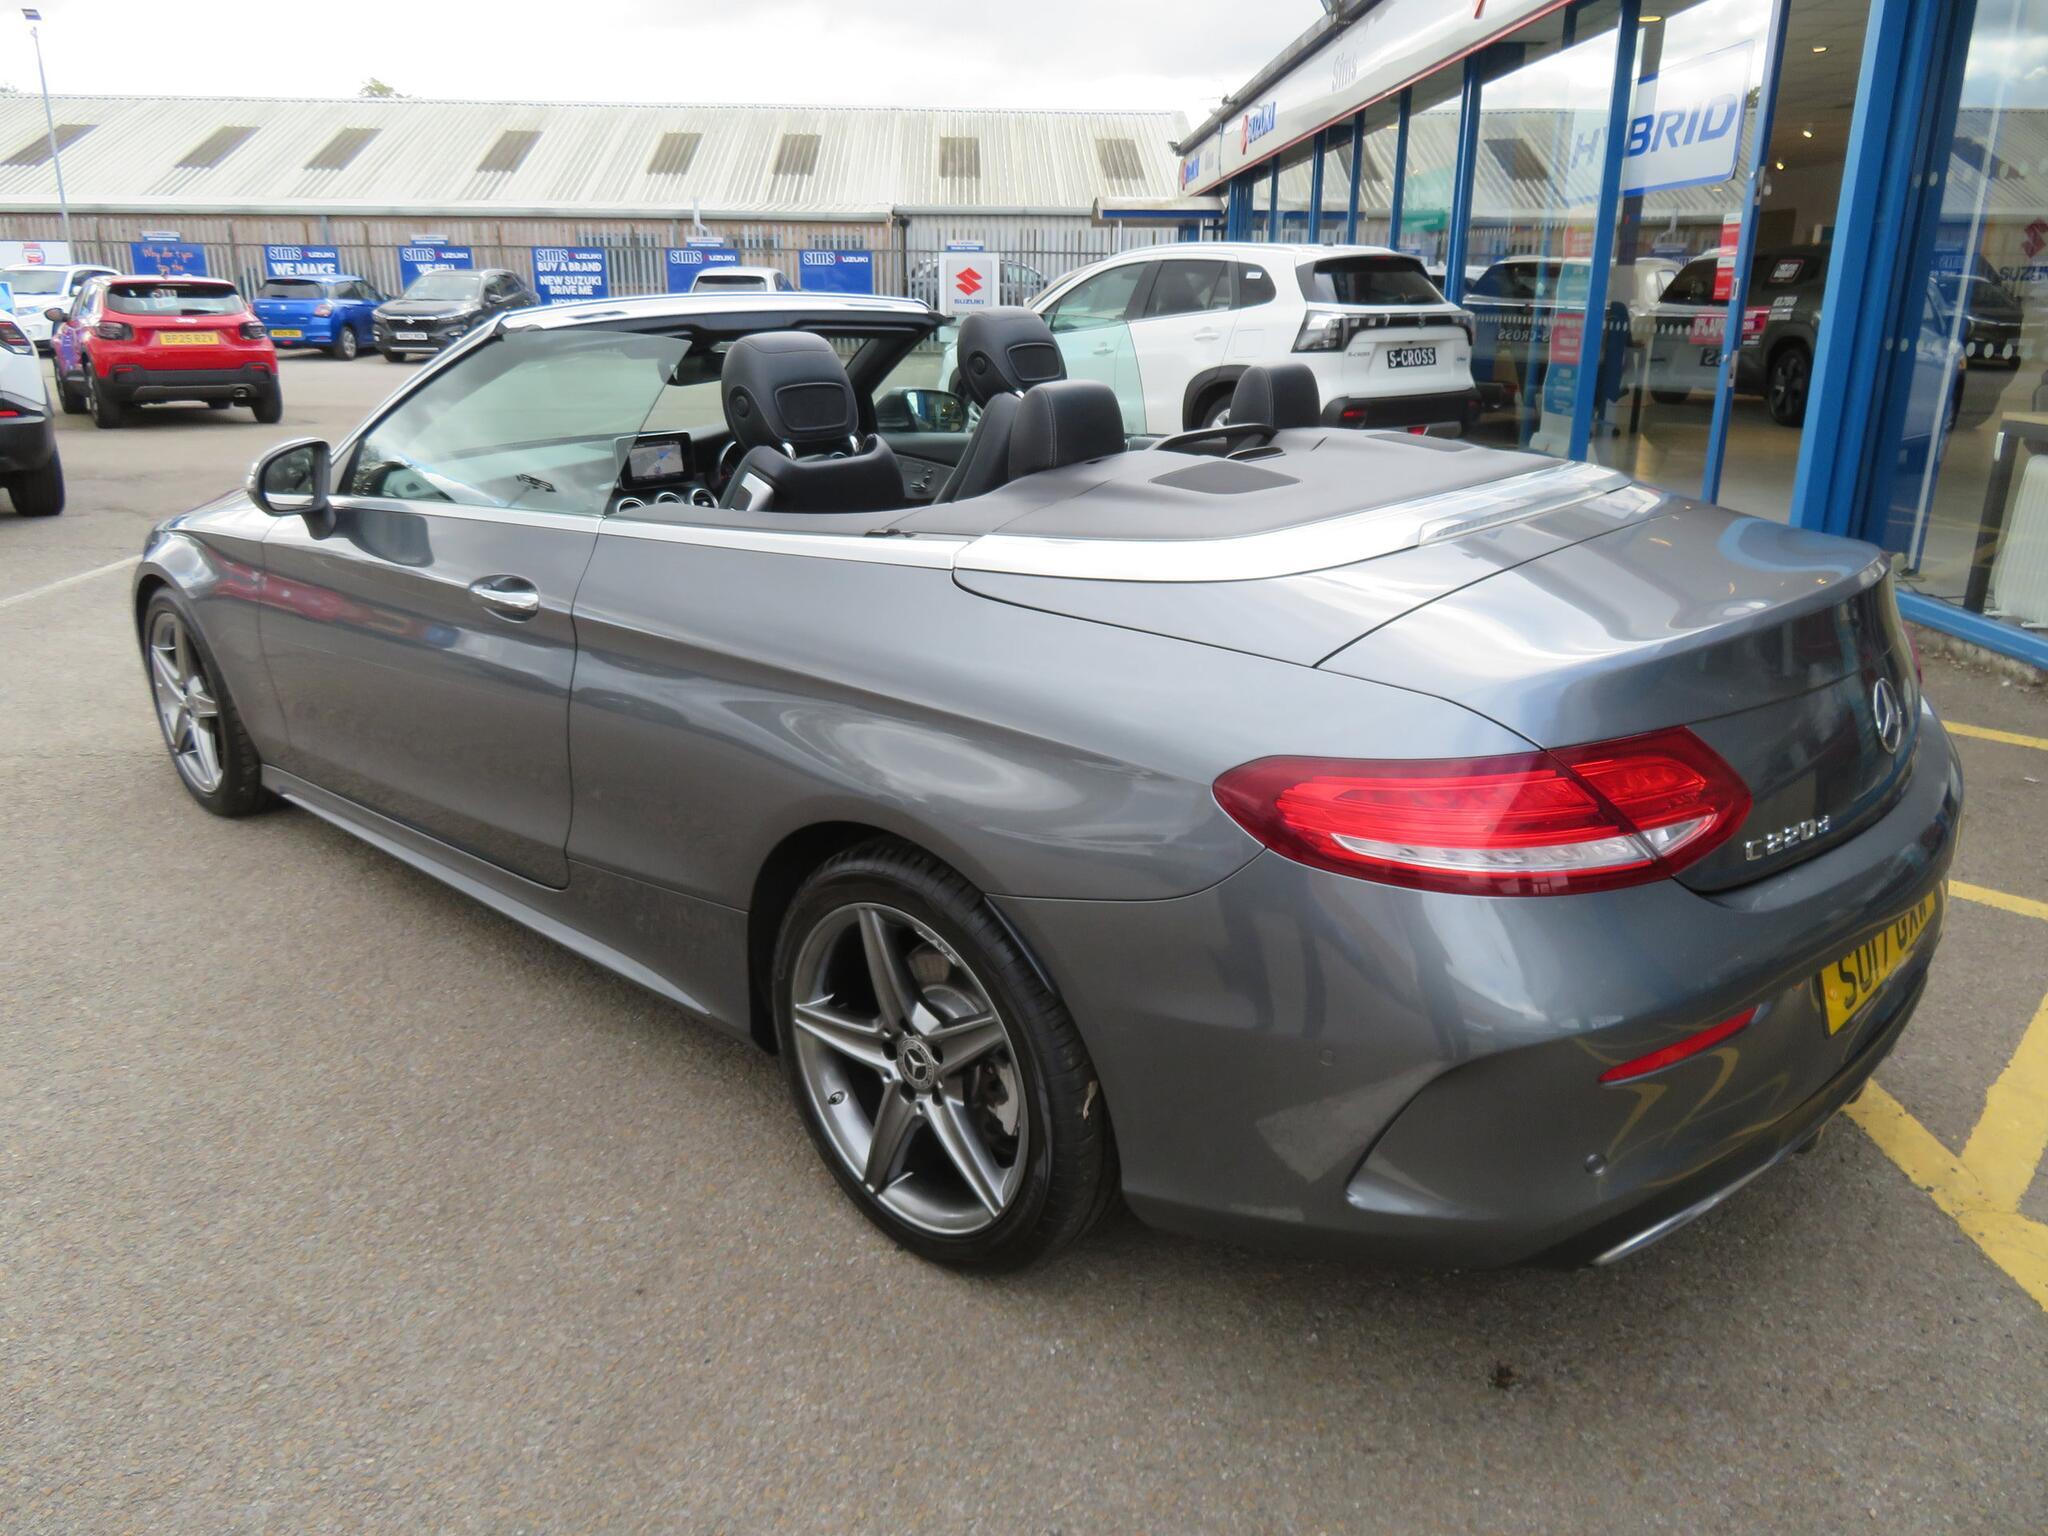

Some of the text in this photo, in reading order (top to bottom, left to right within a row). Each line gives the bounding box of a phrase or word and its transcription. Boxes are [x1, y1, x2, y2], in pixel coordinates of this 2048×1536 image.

[1571, 94, 1738, 169] HBRID
[271, 262, 336, 276] WE MAKE
[538, 262, 602, 272] BUY A BRAND
[539, 275, 602, 286] NEW SUZUKI
[550, 285, 593, 295] DRIVE ME
[1389, 348, 1436, 368] S-CROSS
